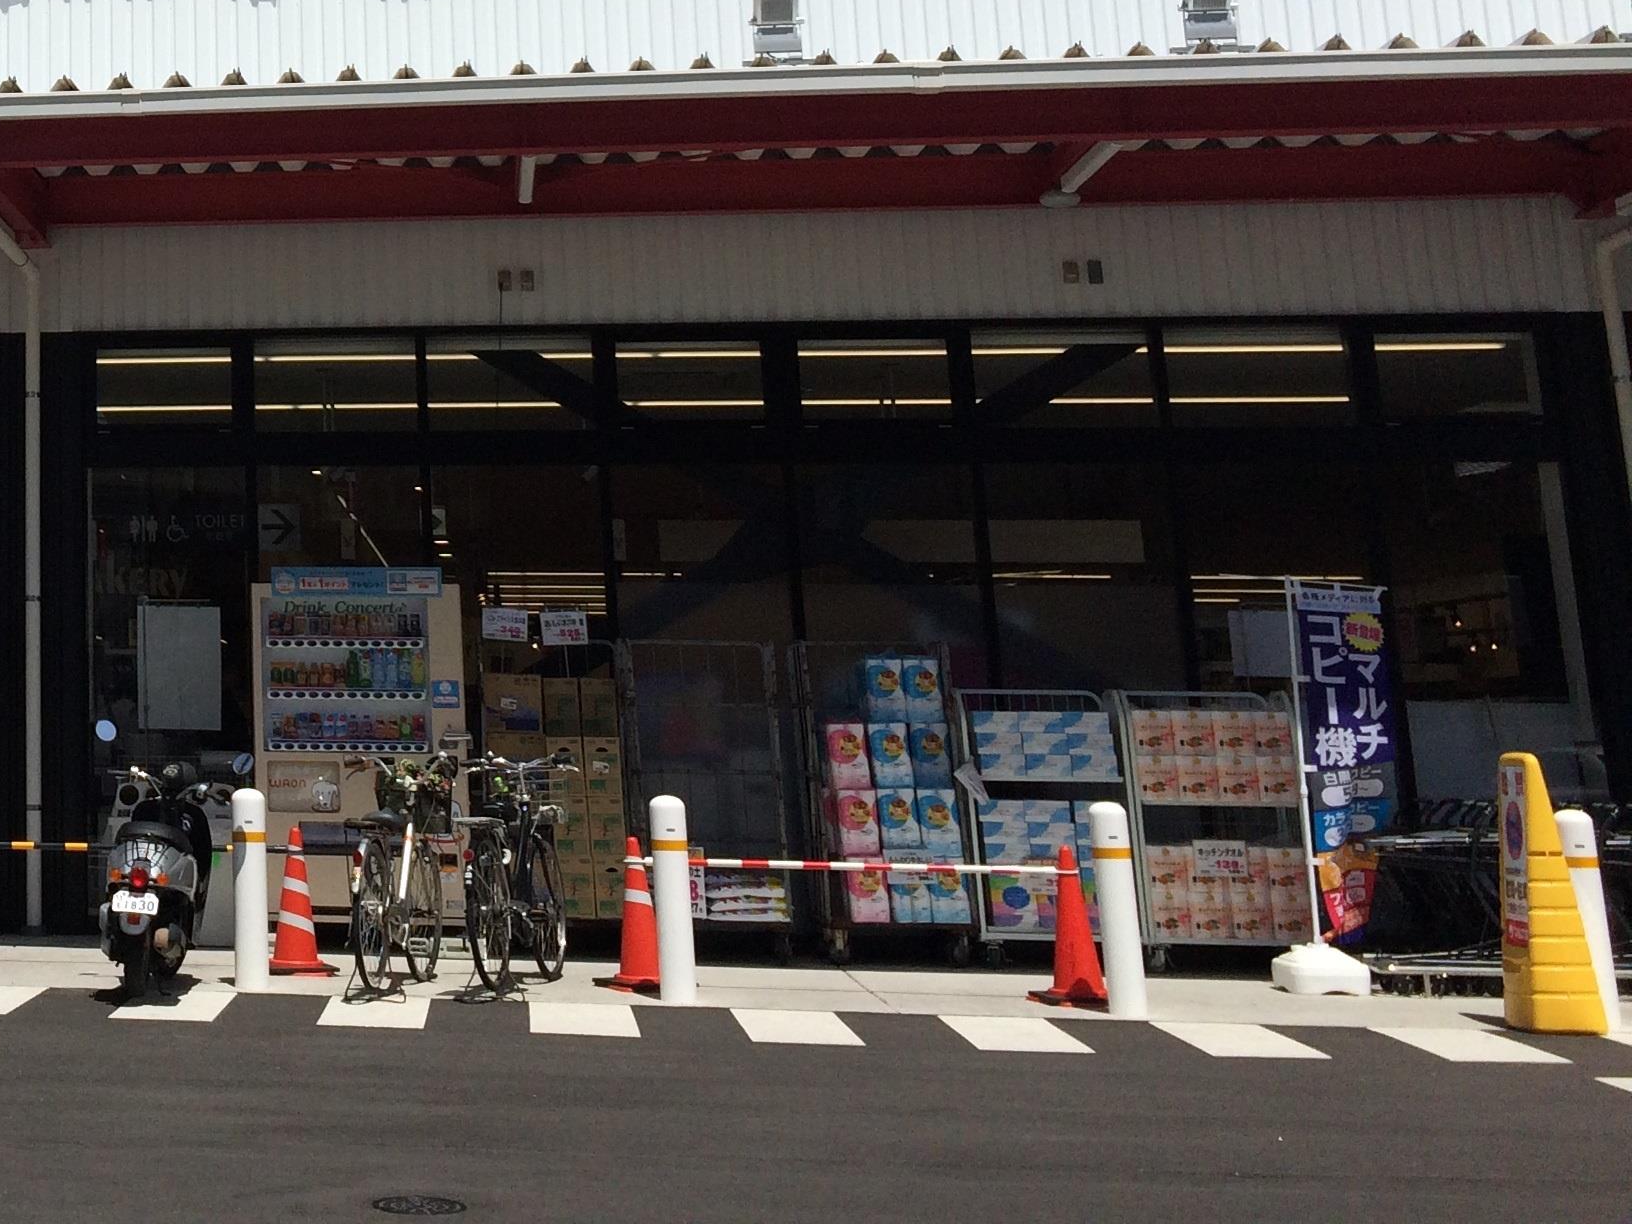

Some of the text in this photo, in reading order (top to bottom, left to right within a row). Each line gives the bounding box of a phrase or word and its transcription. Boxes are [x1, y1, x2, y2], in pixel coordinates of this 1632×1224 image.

[1306, 614, 1357, 768] コピー機
[1348, 653, 1389, 761] マルチ
